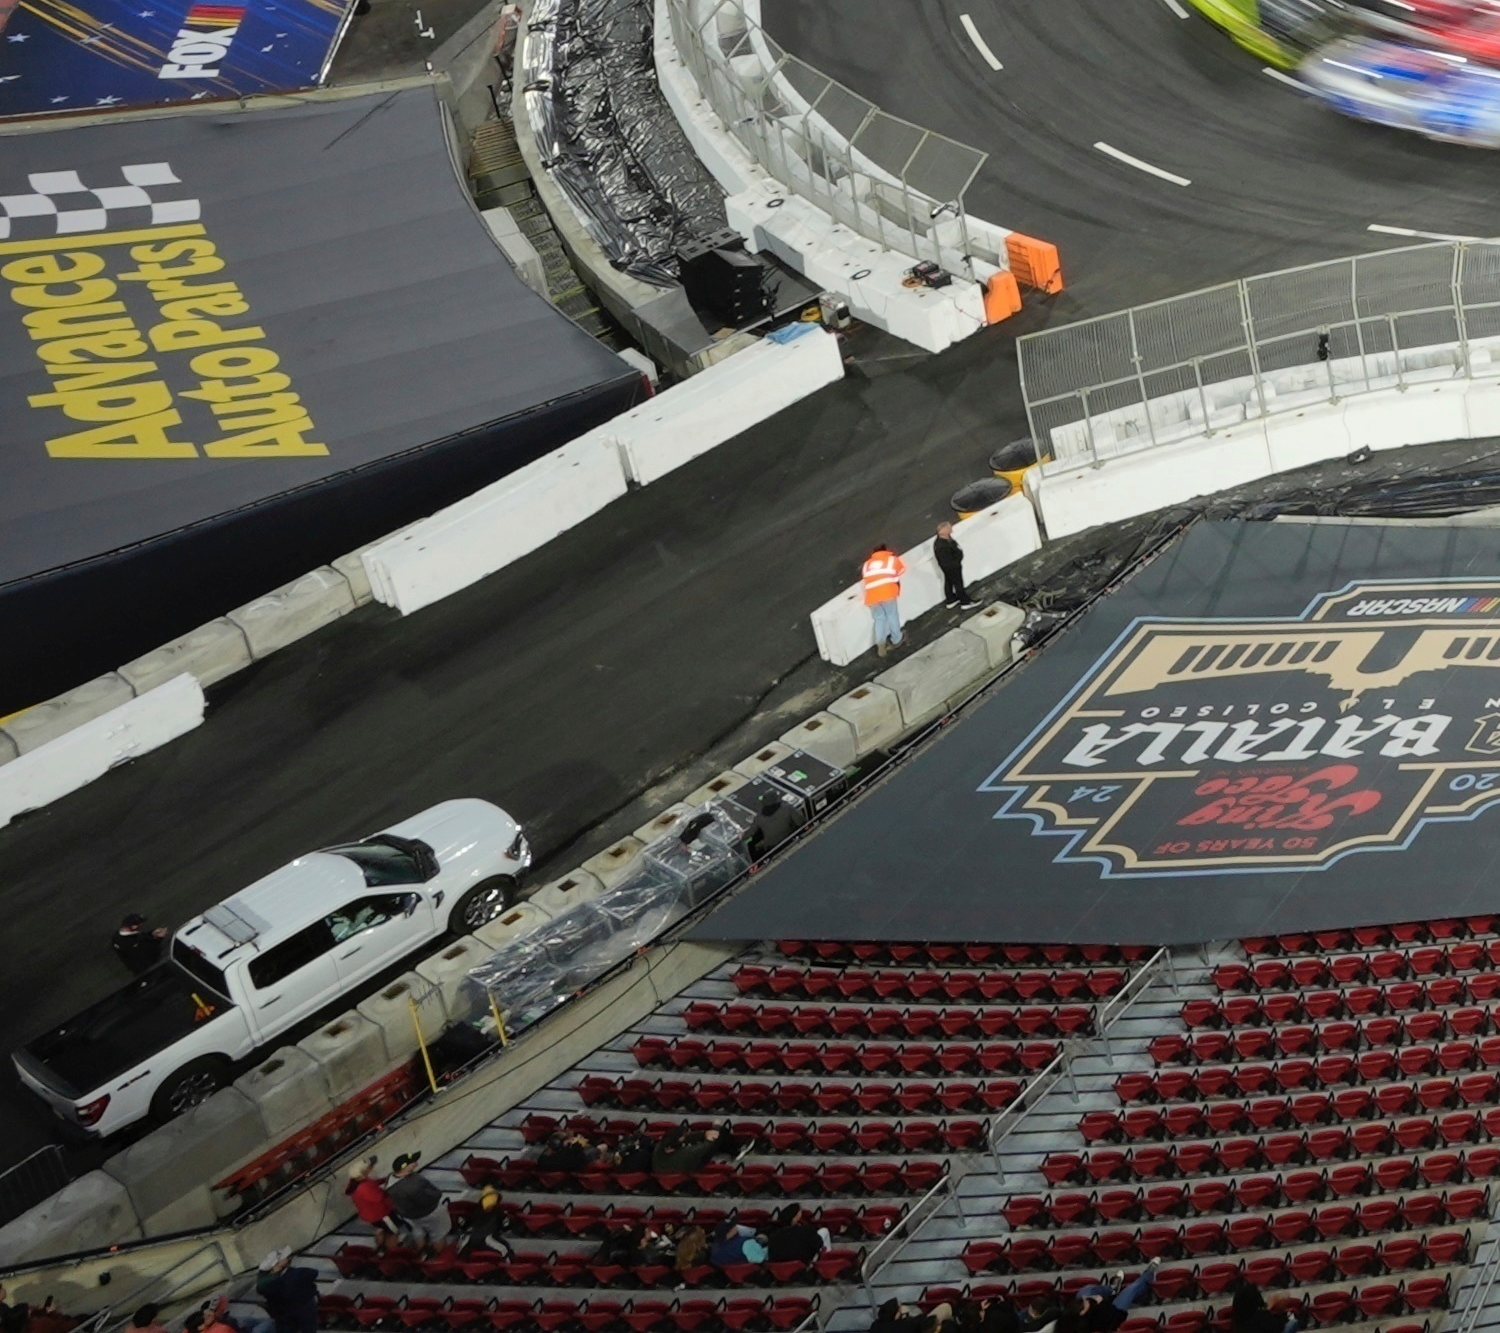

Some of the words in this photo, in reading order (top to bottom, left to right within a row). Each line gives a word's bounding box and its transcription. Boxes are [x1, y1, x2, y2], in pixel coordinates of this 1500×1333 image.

[158, 23, 235, 82] FOX
[0, 249, 201, 459] Advance
[1348, 596, 1465, 618] NASCAR
[1140, 701, 1318, 719] COLISEO
[1379, 697, 1434, 712] EL
[1060, 713, 1453, 767] BATALLA
[1193, 764, 1359, 801] Taco
[1070, 784, 1122, 803] 24
[1175, 789, 1382, 833] King
[1152, 840, 1189, 854] OF
[1197, 837, 1276, 852] YEARS
[1285, 835, 1318, 849] 50
